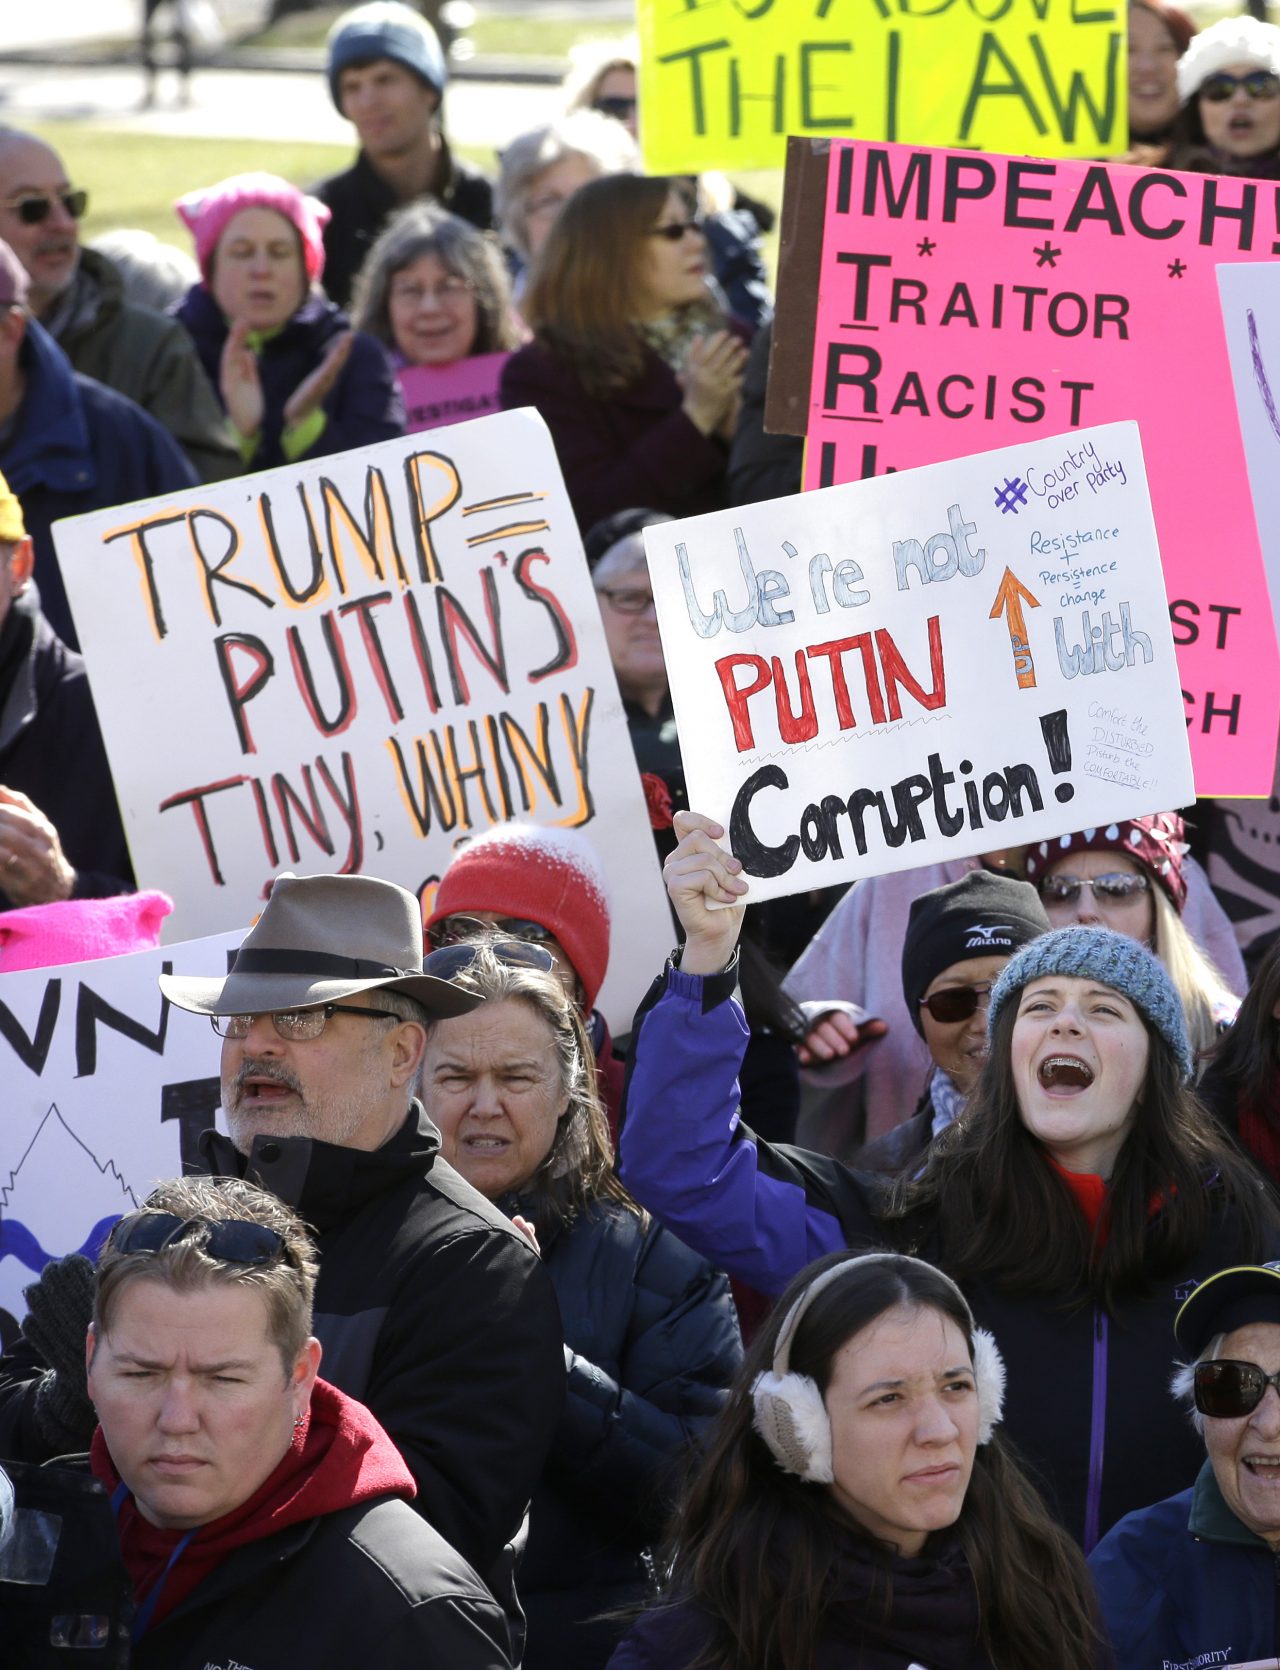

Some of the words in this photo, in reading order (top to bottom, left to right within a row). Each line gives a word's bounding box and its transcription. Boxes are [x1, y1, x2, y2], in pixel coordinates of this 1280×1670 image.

[658, 39, 854, 138] THE
[836, 251, 1131, 342] TRAITOR
[823, 341, 1095, 428] RACIST
[1047, 480, 1080, 509] over
[673, 526, 871, 639] We're
[892, 503, 987, 591] not
[1030, 528, 1120, 555] Resistance
[1038, 560, 1119, 585] Persistence
[214, 547, 580, 755] PUTIN'S
[714, 615, 947, 753] PUTIN
[1052, 601, 1154, 681] With
[728, 708, 1075, 879] Corruption!
